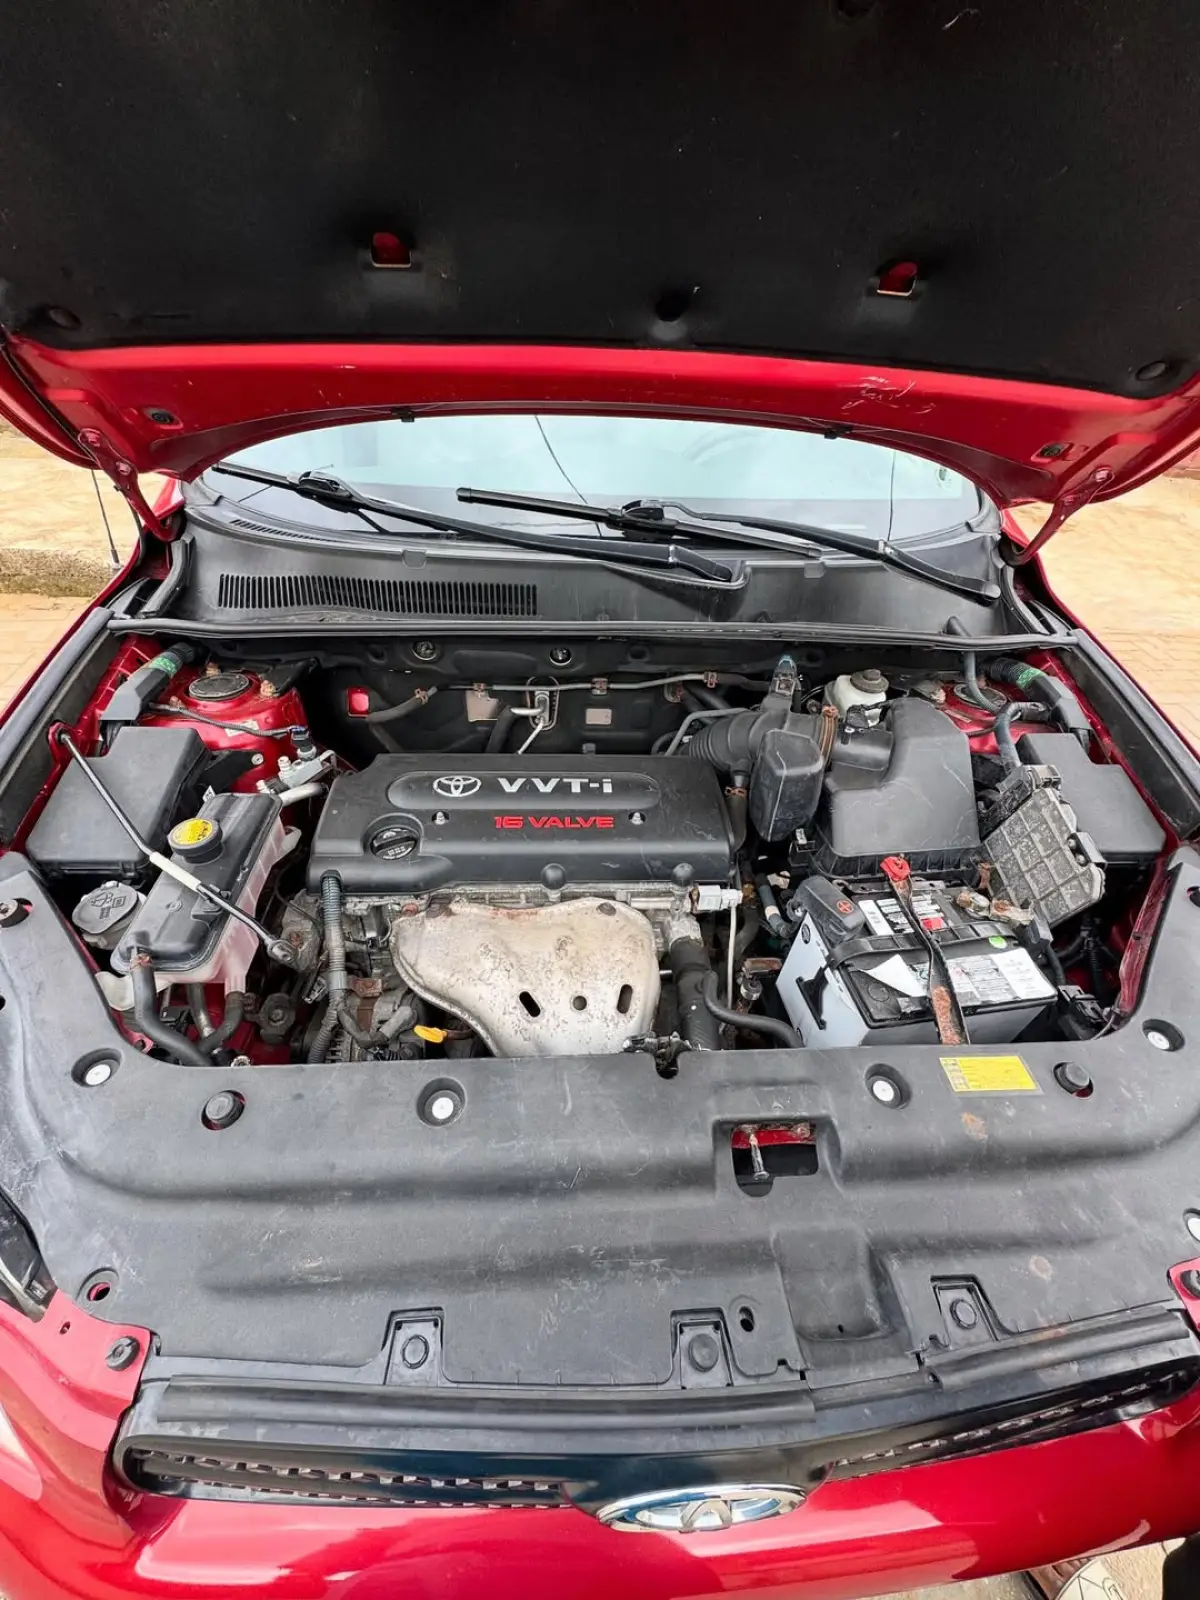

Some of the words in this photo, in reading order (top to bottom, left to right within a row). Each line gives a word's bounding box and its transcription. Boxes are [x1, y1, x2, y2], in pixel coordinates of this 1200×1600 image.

[497, 777, 613, 793] VVT-i
[494, 815, 524, 829] 16
[527, 815, 615, 829] VALVE
